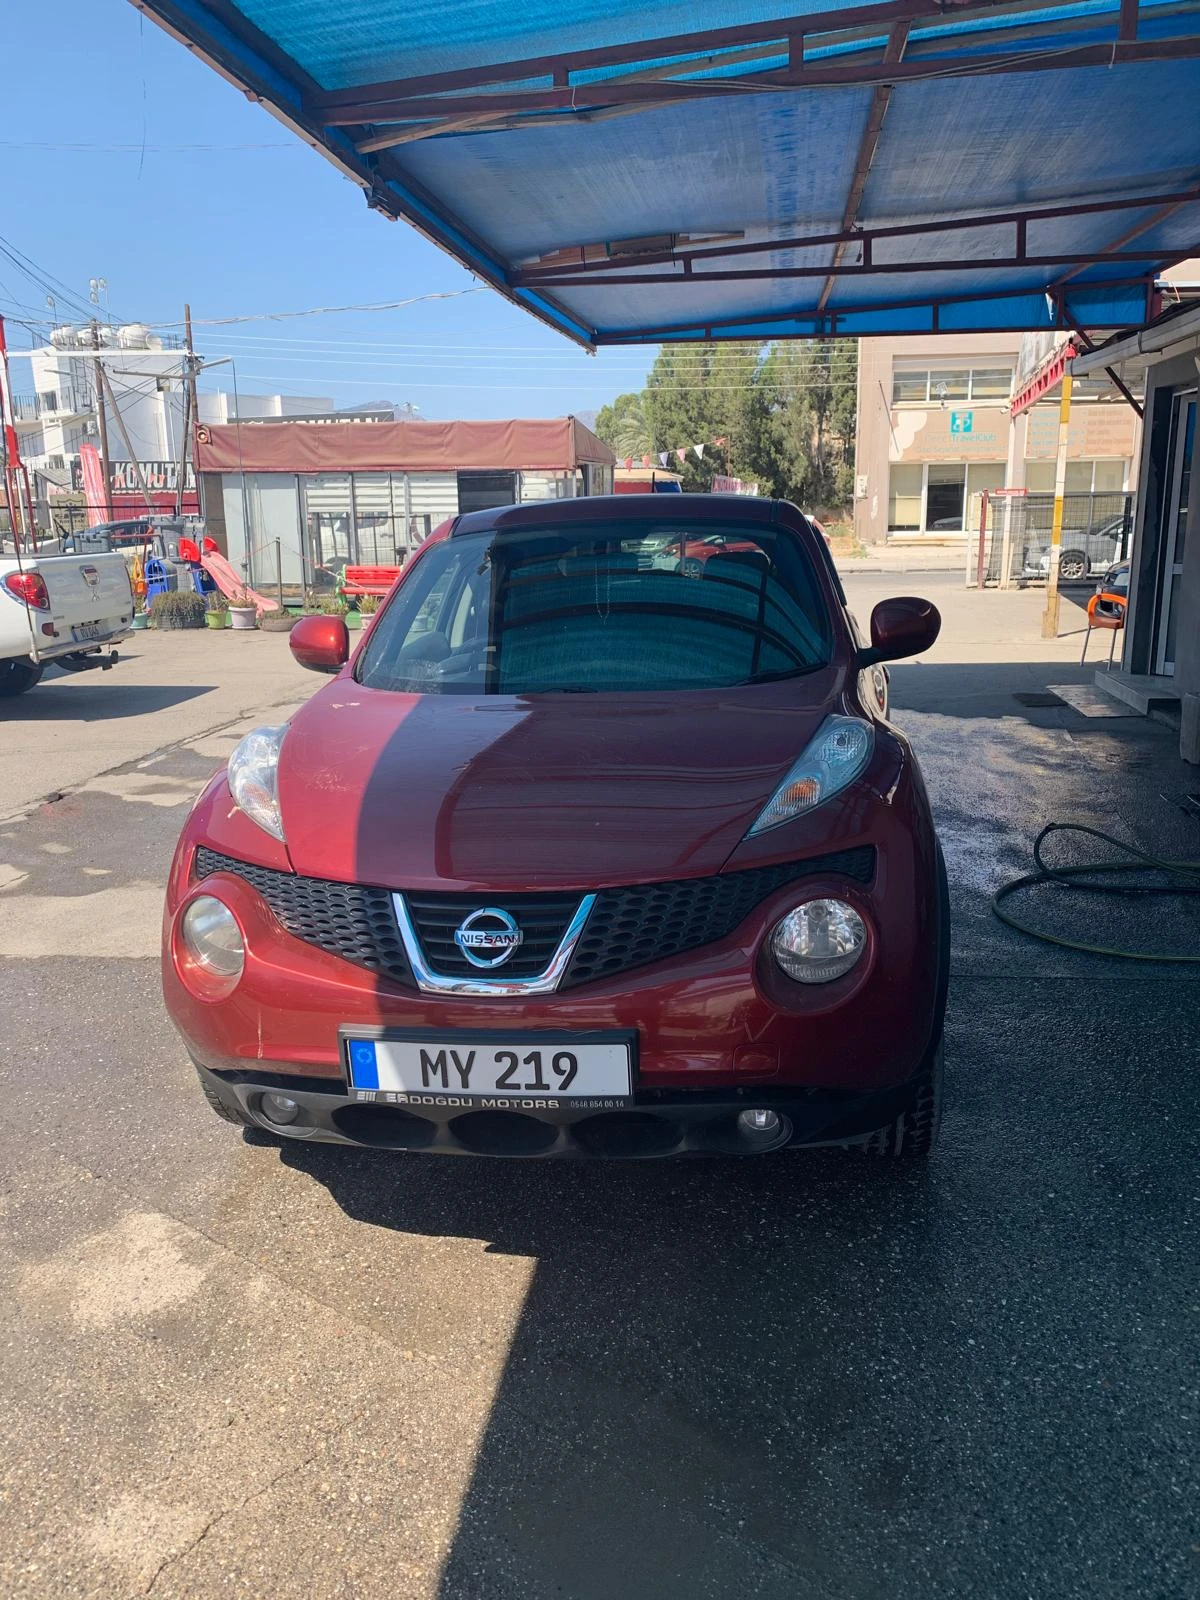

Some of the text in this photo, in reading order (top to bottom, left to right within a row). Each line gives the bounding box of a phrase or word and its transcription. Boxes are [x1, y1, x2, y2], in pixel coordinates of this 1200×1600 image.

[460, 934, 515, 944] NISSAN
[419, 1049, 578, 1091] MY 219
[481, 1099, 560, 1109] MOTORS
